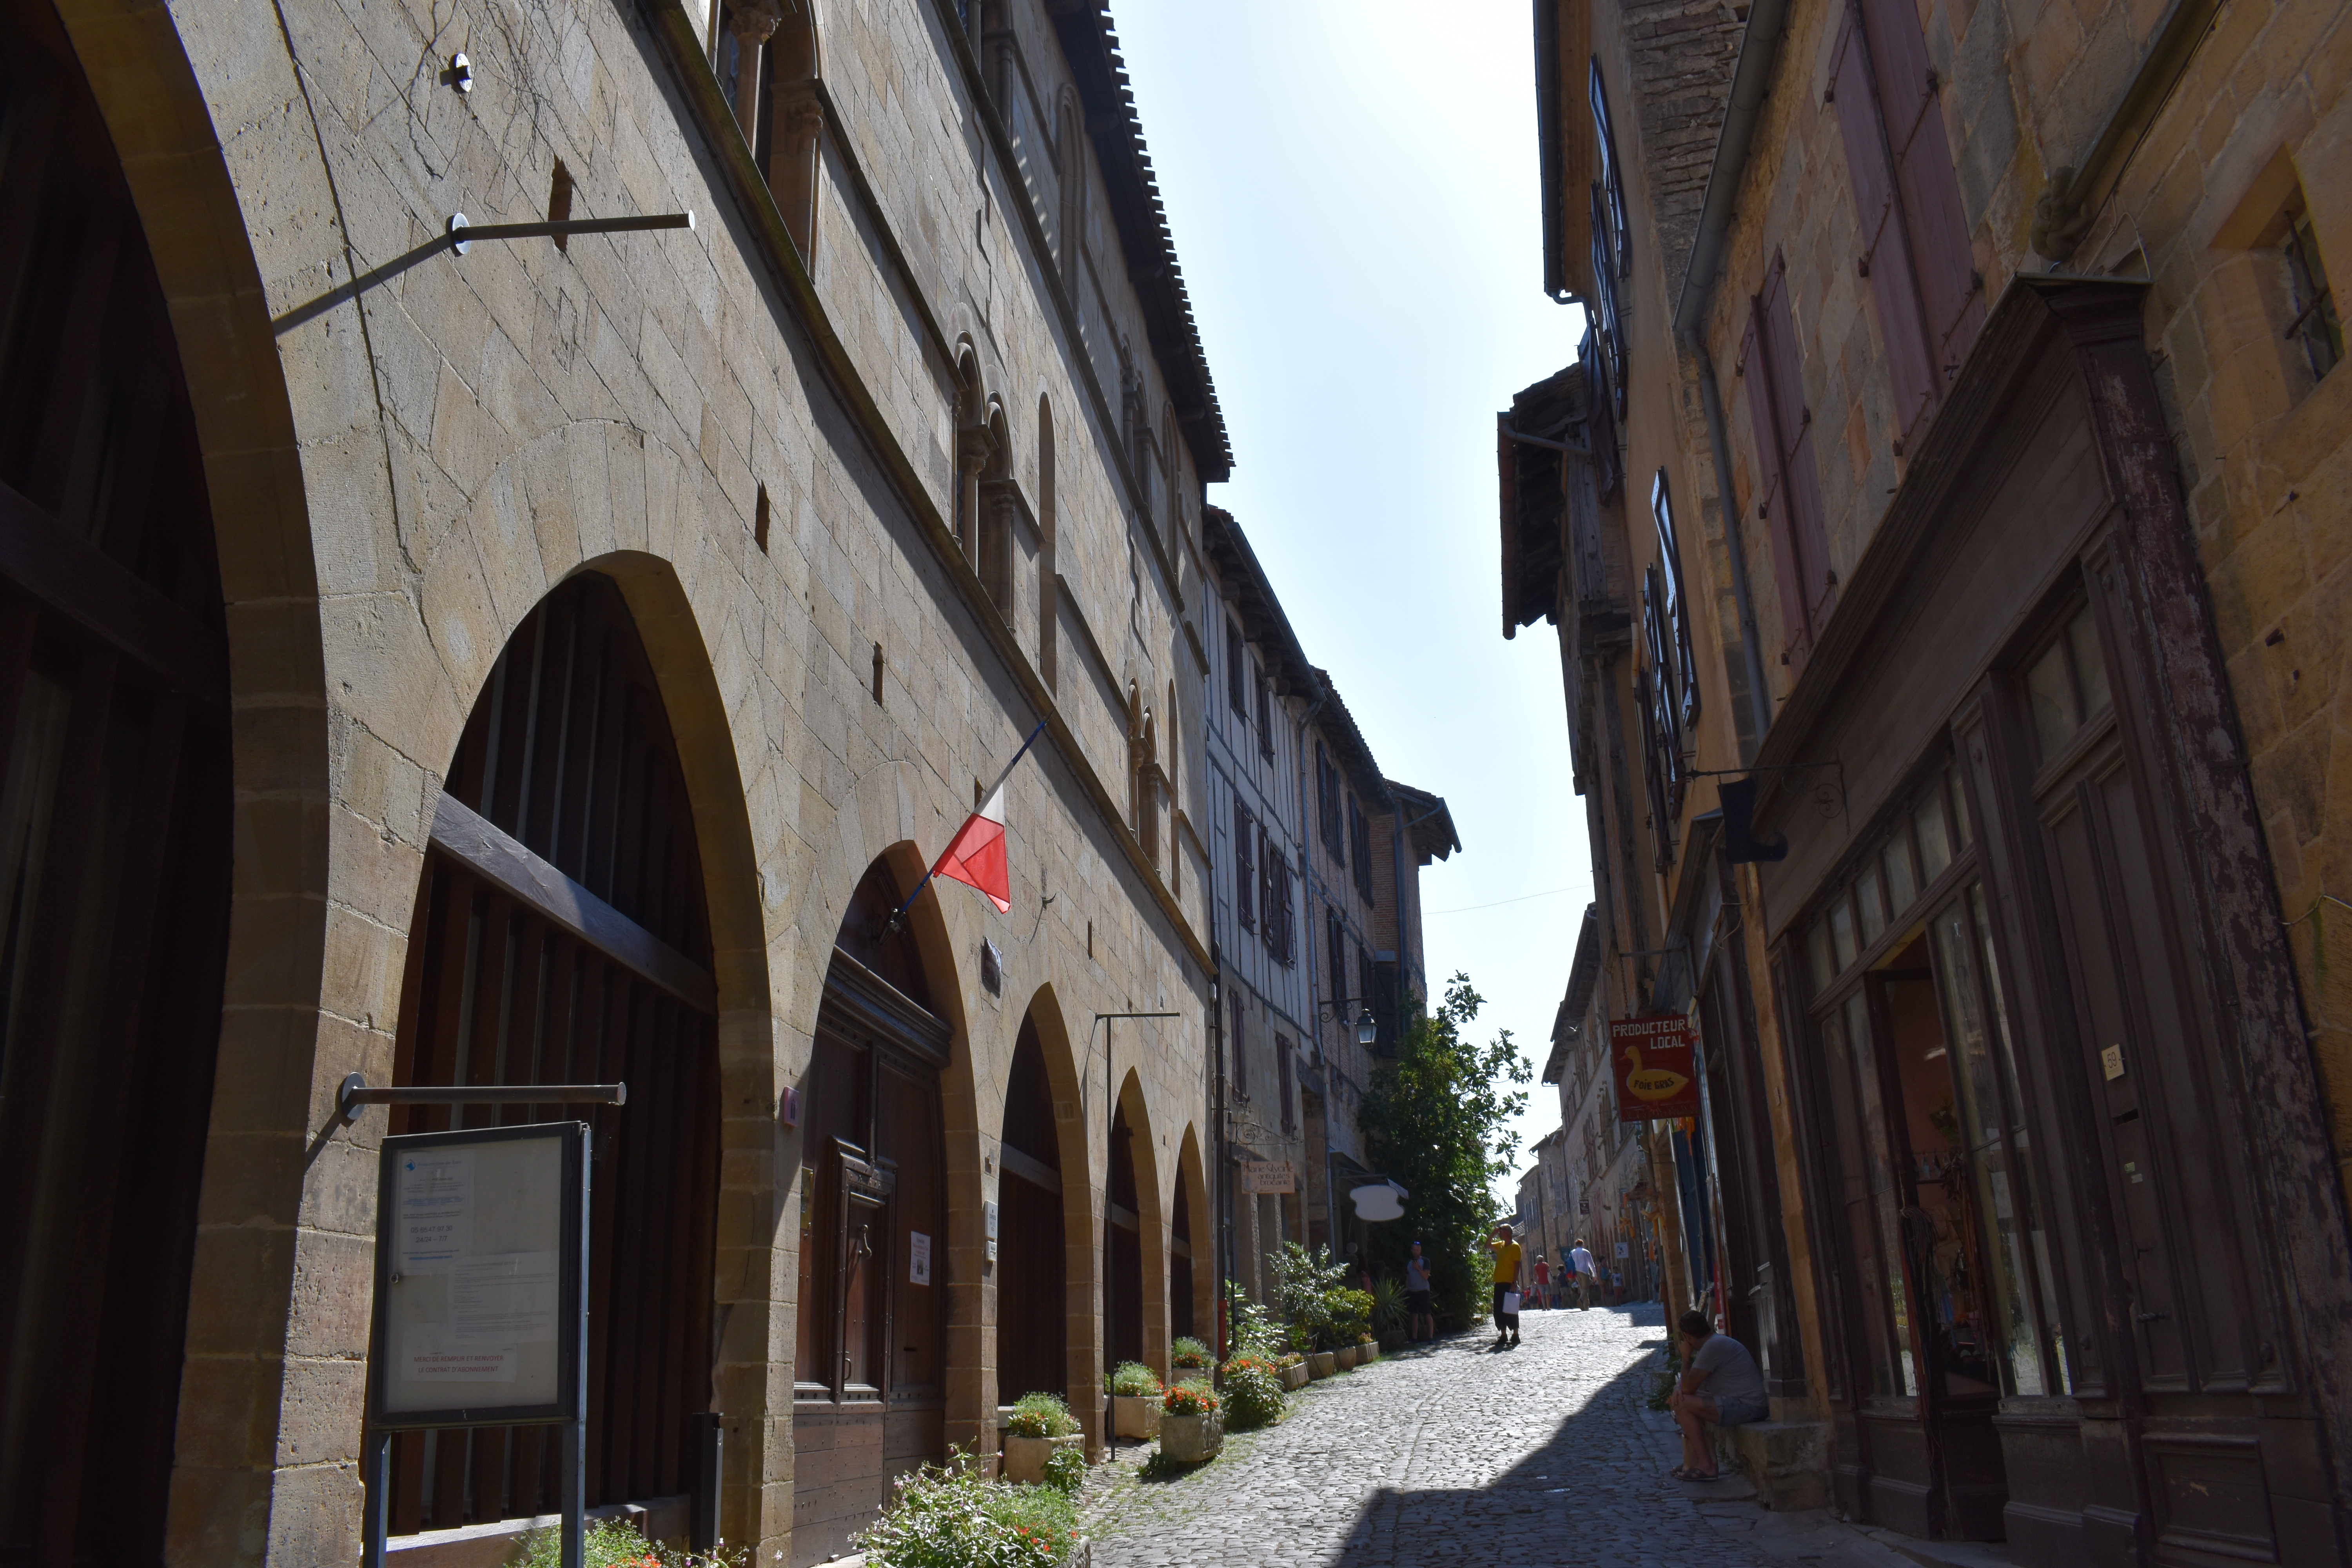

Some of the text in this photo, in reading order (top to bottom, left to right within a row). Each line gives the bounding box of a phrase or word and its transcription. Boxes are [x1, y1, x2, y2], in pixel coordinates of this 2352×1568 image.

[1613, 1019, 1686, 1037] PRODUCTEUR
[1650, 1035, 1685, 1049] LOCAL
[2107, 1051, 2117, 1068] 59
[1655, 1078, 1675, 1090] GRAS
[1242, 1163, 1293, 1173] Marie Glycine
